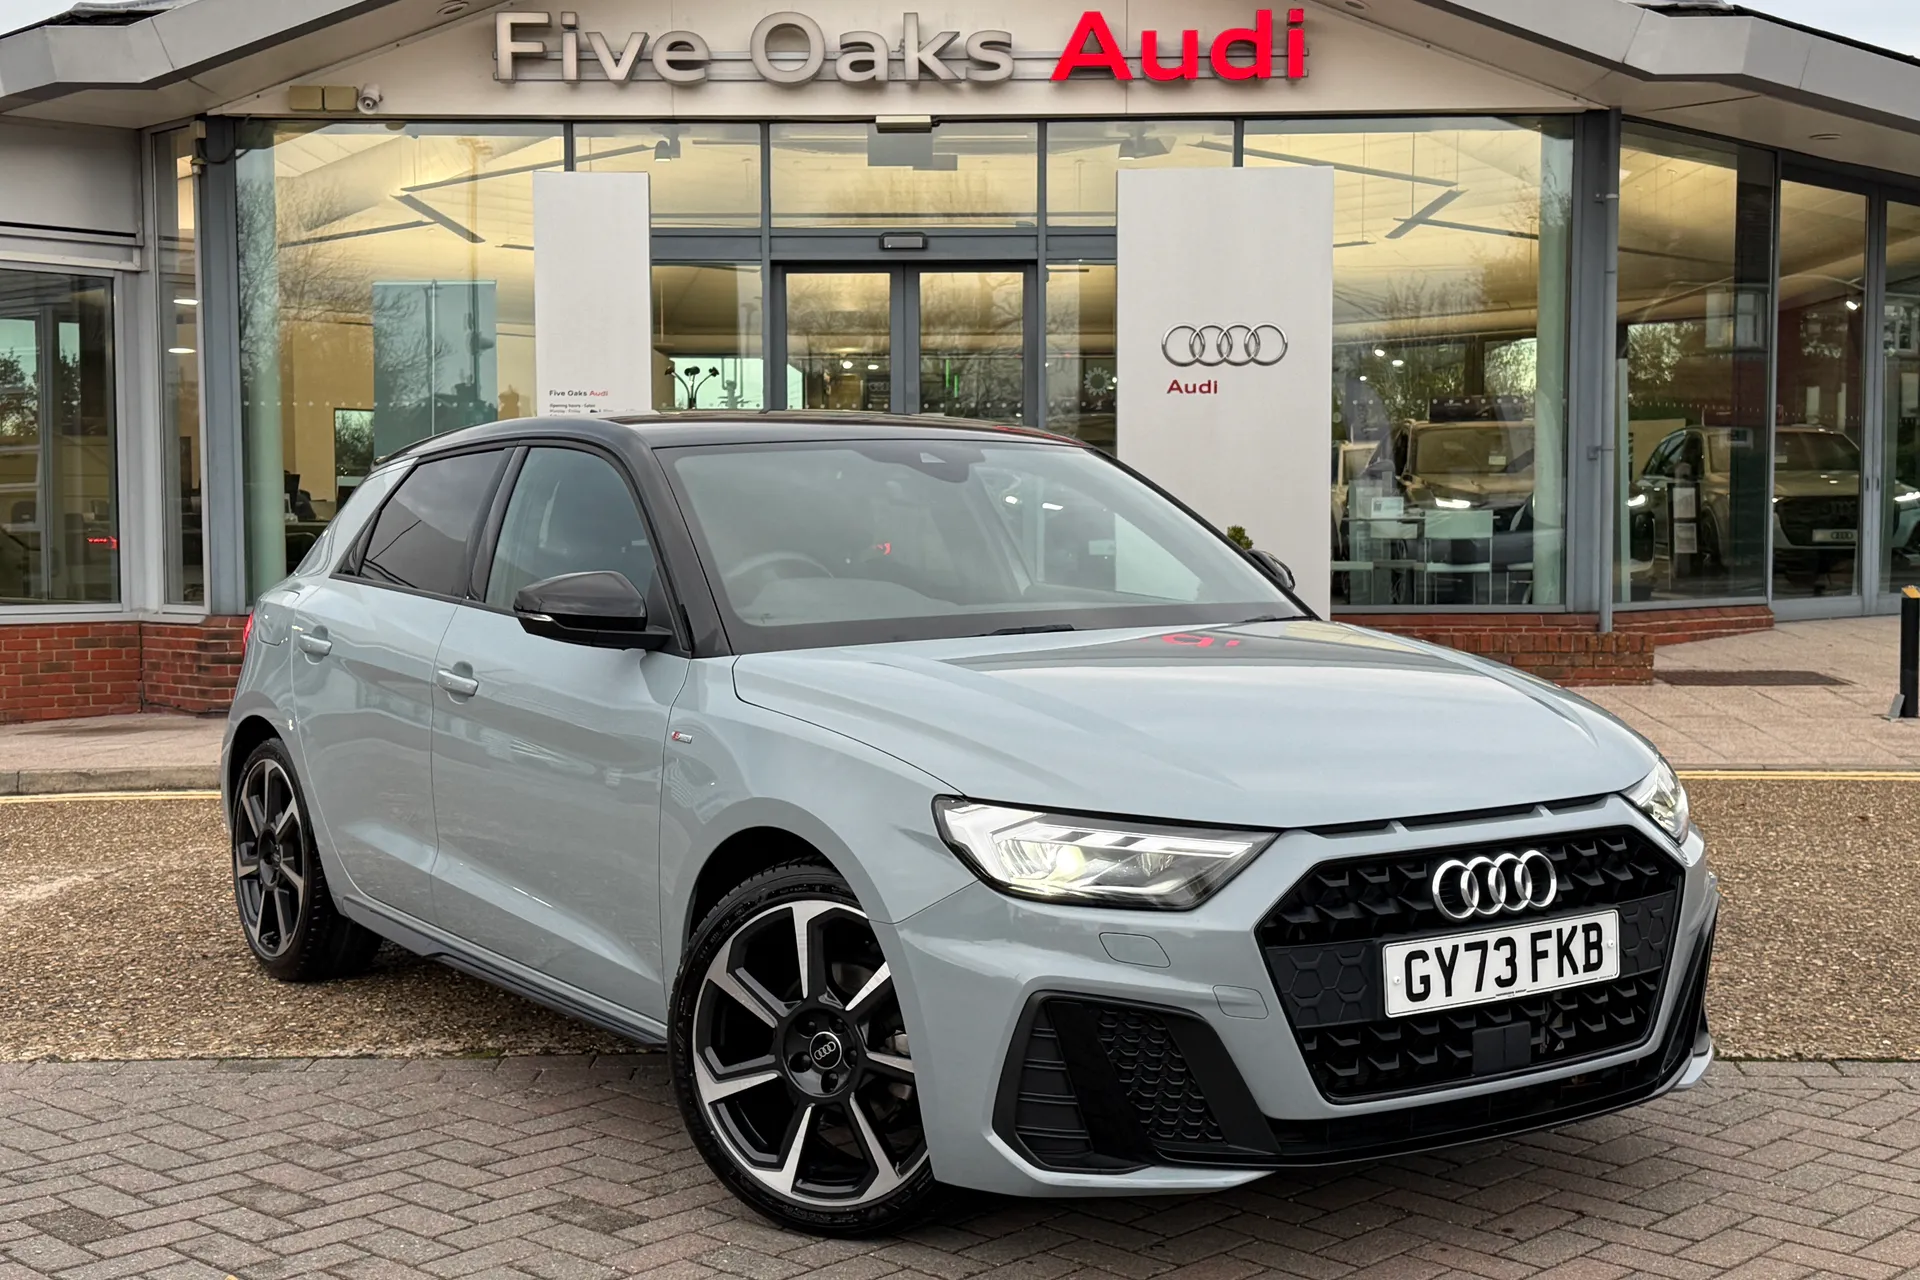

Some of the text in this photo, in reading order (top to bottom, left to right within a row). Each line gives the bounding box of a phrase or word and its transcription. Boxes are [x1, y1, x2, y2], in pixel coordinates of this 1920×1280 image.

[495, 9, 1305, 85] Five Oaks Audi
[549, 389, 566, 397] Five
[567, 389, 588, 397] Oaks
[1166, 379, 1218, 394] Audi
[1404, 921, 1604, 1003] GY73 FKB
